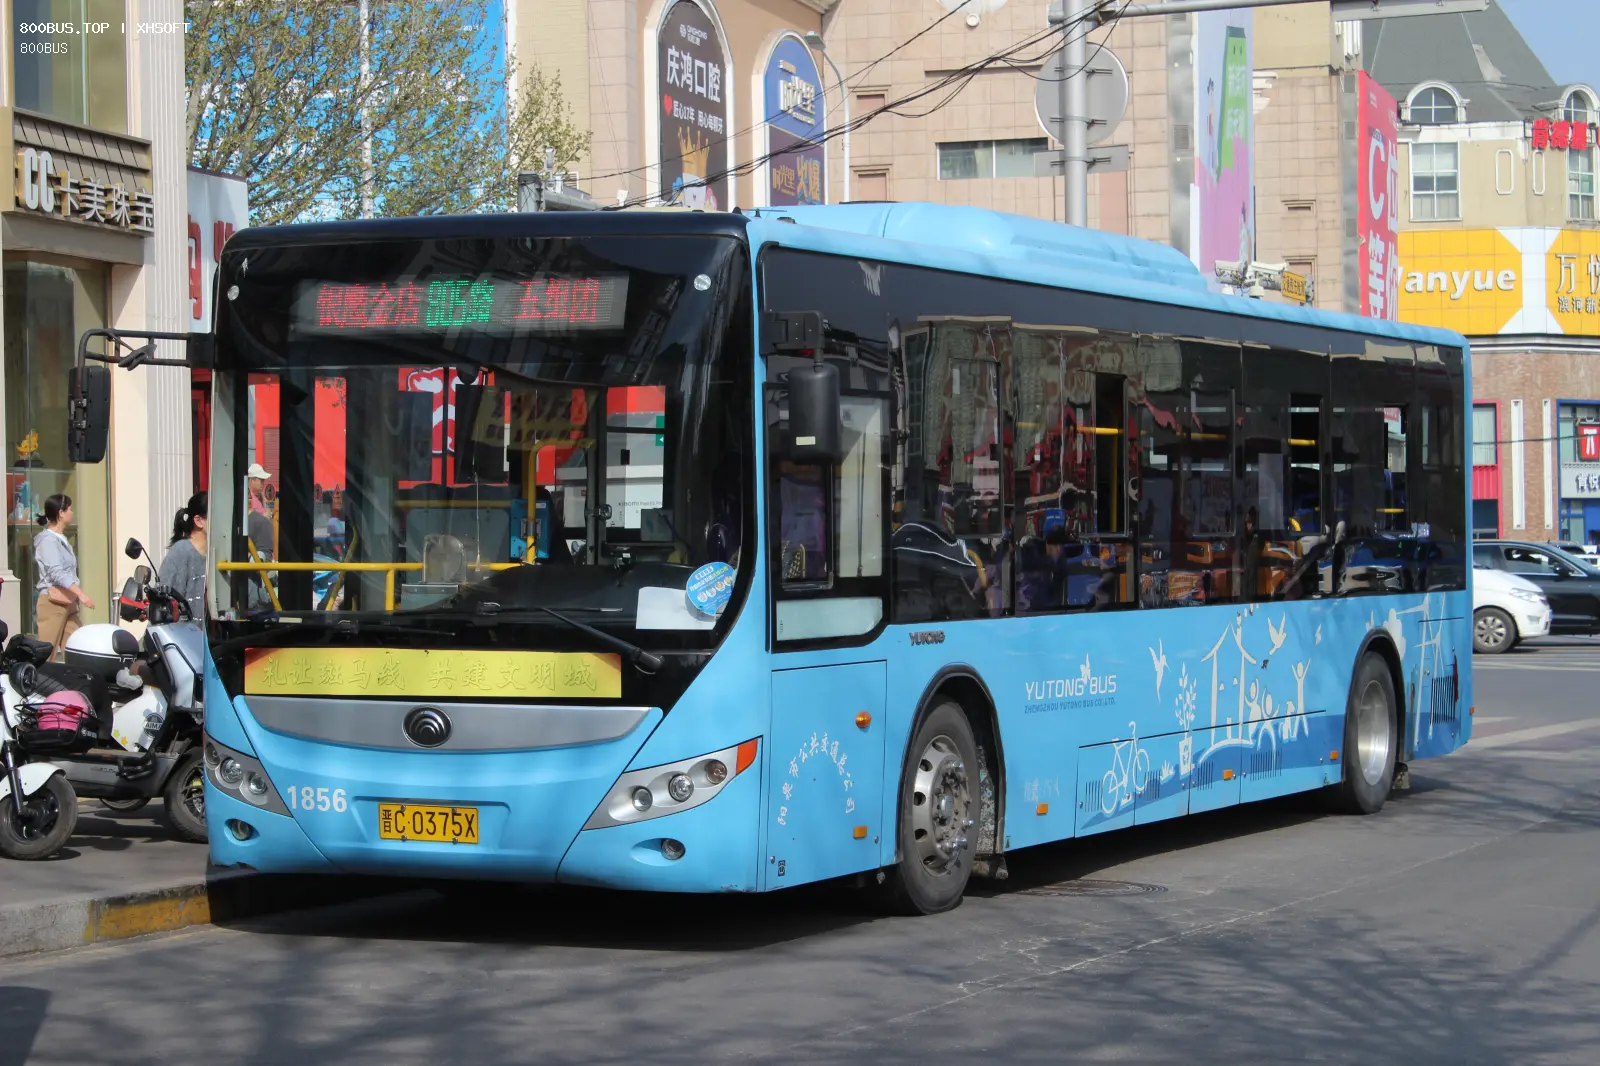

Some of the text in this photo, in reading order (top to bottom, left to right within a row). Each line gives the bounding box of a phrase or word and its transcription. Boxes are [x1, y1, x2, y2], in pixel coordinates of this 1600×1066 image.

[666, 45, 721, 103] 庆鸿口腔
[1532, 118, 1588, 151] 肯德基
[1399, 267, 1517, 300] anyue
[1557, 296, 1600, 314] 滨河新
[261, 656, 598, 692] 礼让斑马线 共建文明城
[1025, 674, 1117, 701] YUTONG BUS
[1059, 699, 1082, 711] YUTONG
[287, 785, 348, 813] 1856
